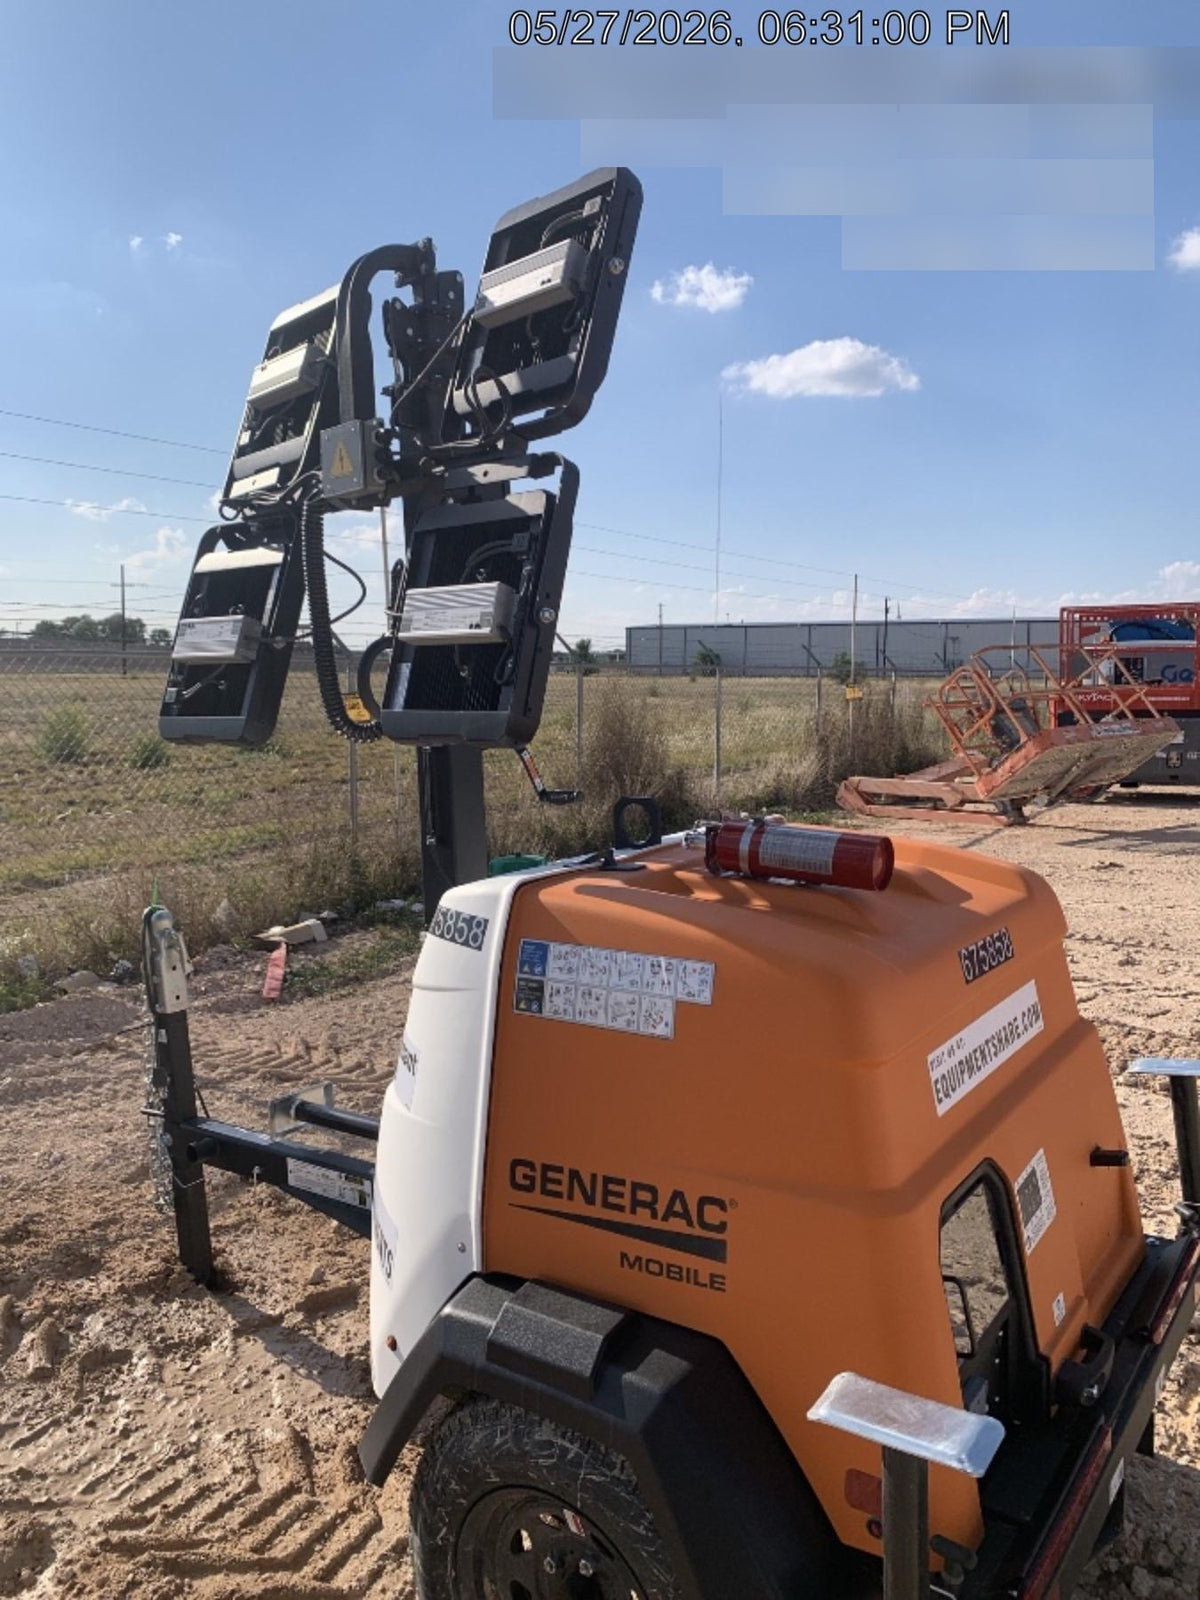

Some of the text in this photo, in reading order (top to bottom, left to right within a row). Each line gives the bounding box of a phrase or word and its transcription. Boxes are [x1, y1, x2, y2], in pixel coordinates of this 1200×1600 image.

[959, 928, 1014, 982] 675858
[933, 1001, 1041, 1105] EQUIPMENTSHARE.COM
[508, 1158, 728, 1235] GENERAC
[619, 1251, 727, 1293] MOBILE
